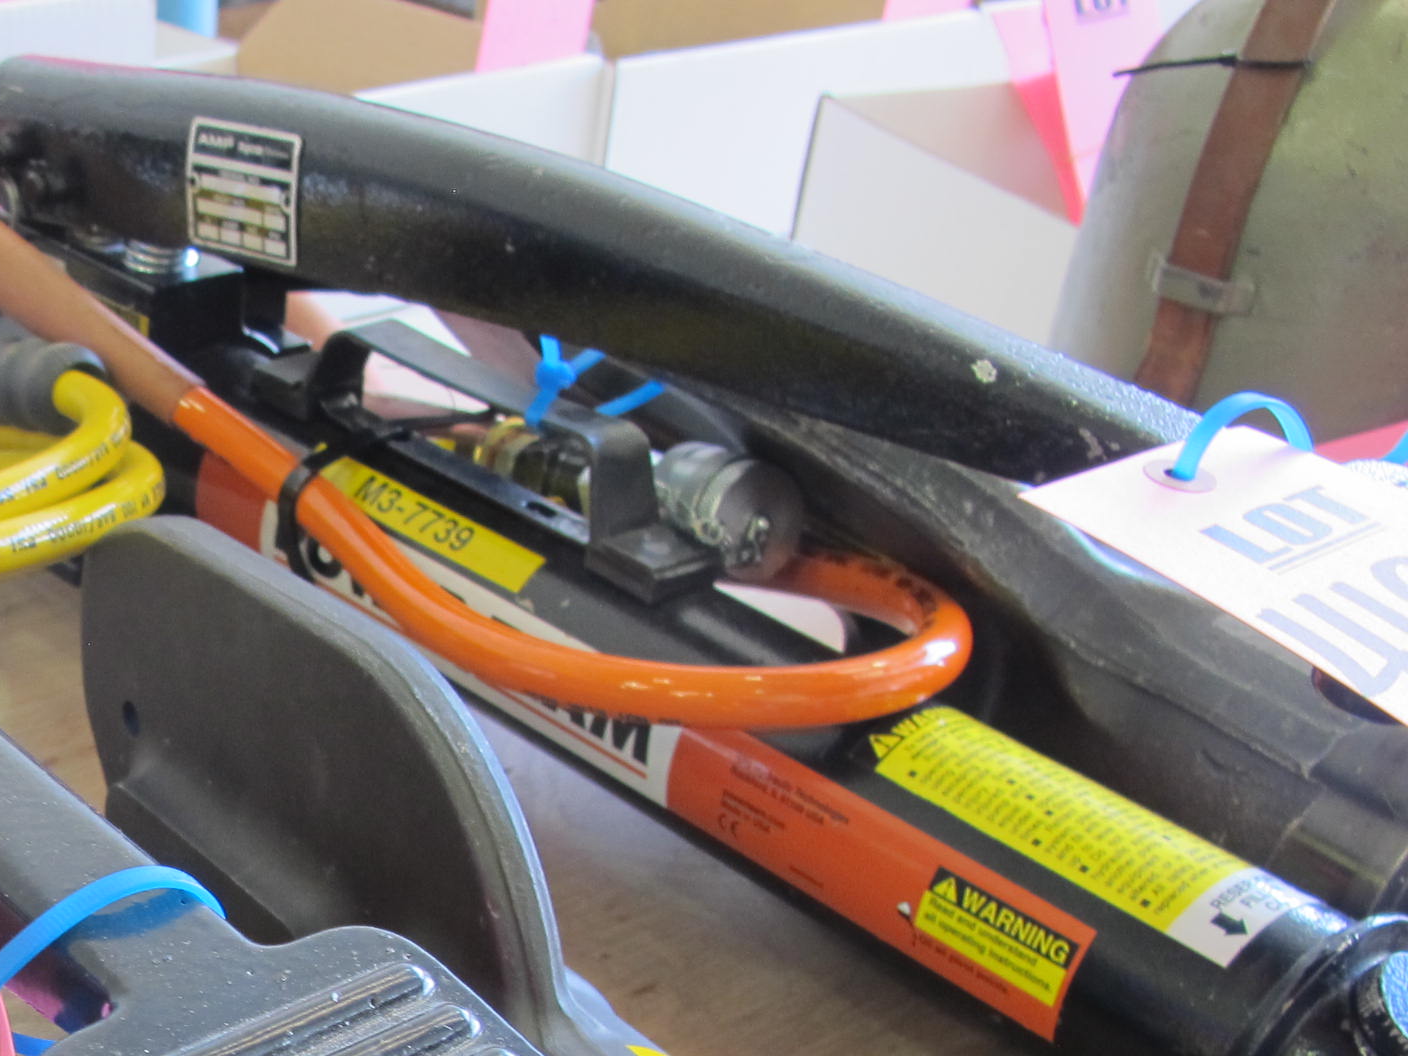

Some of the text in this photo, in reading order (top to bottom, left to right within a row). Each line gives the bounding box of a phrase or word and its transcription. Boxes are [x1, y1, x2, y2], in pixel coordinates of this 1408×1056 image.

[353, 475, 475, 552] M3-7739
[1199, 485, 1369, 565] LOT
[961, 886, 1070, 966] WARNING
